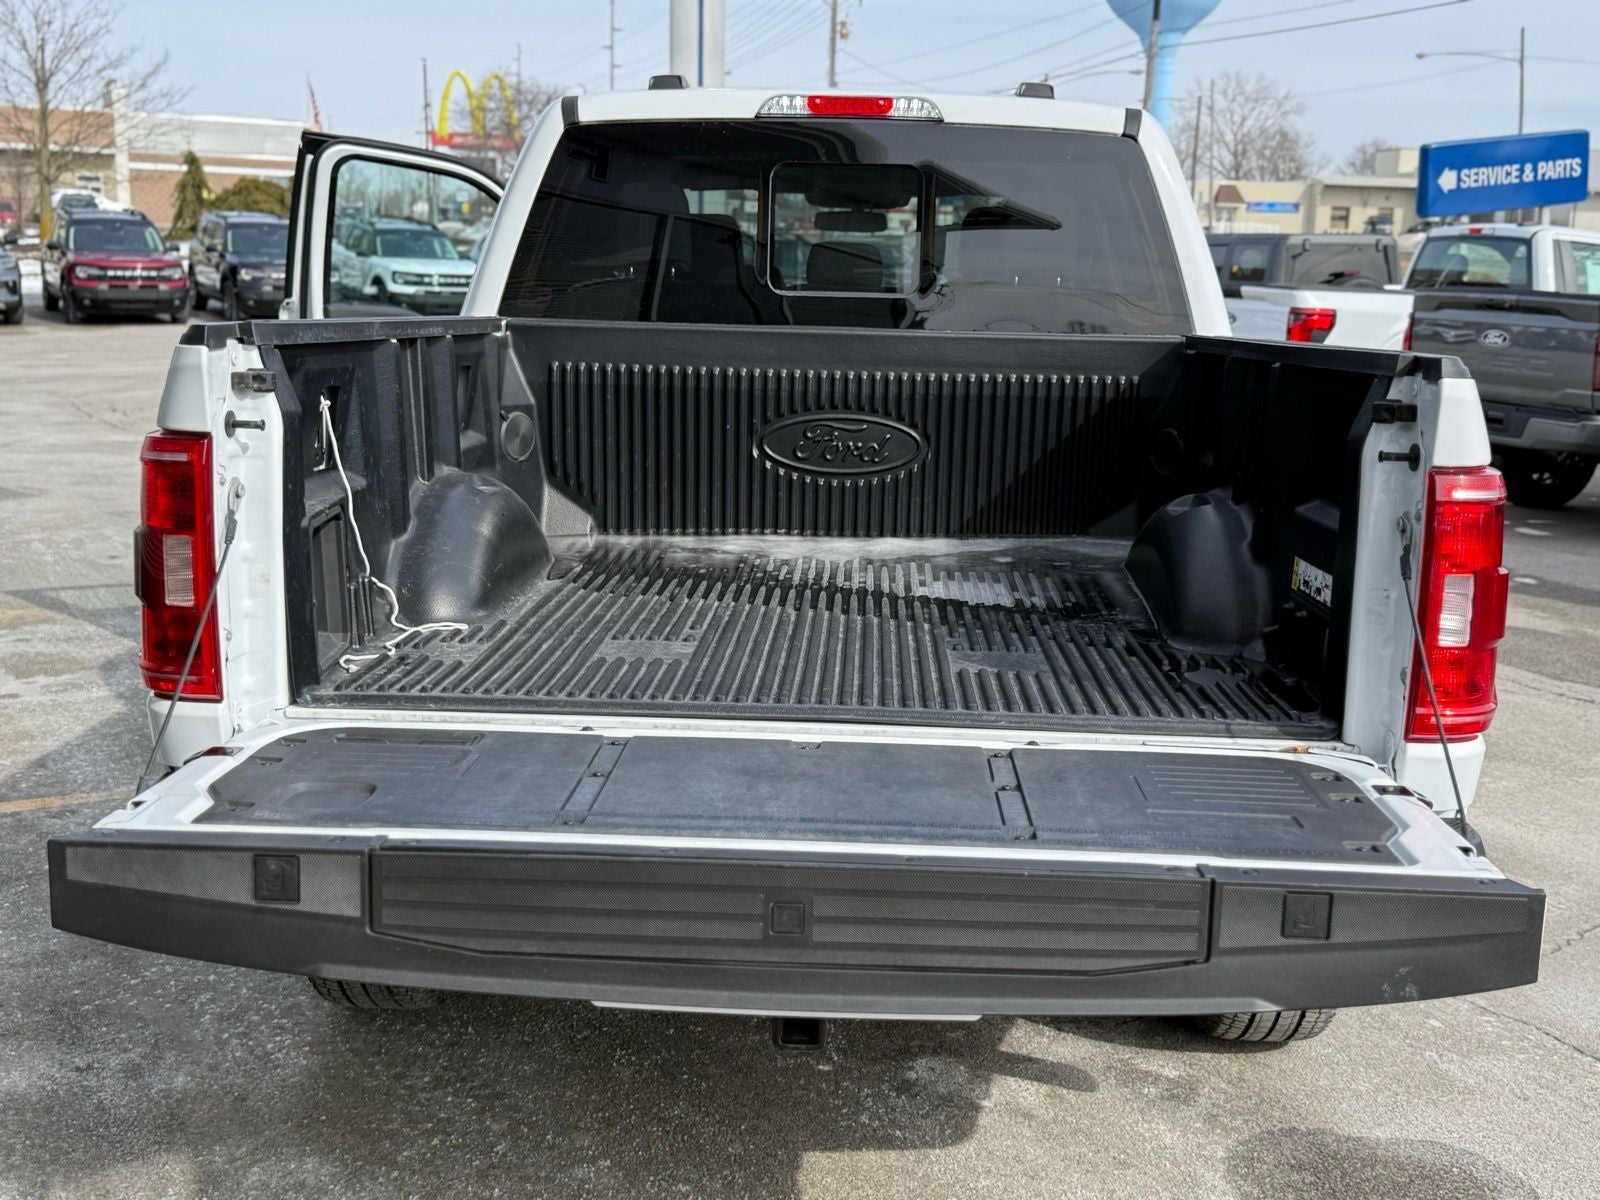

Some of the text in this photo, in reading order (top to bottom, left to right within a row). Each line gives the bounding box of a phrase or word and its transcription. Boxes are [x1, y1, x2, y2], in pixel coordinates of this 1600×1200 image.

[1460, 157, 1582, 189] SERVICE & PARTS
[794, 422, 891, 462] Ford
